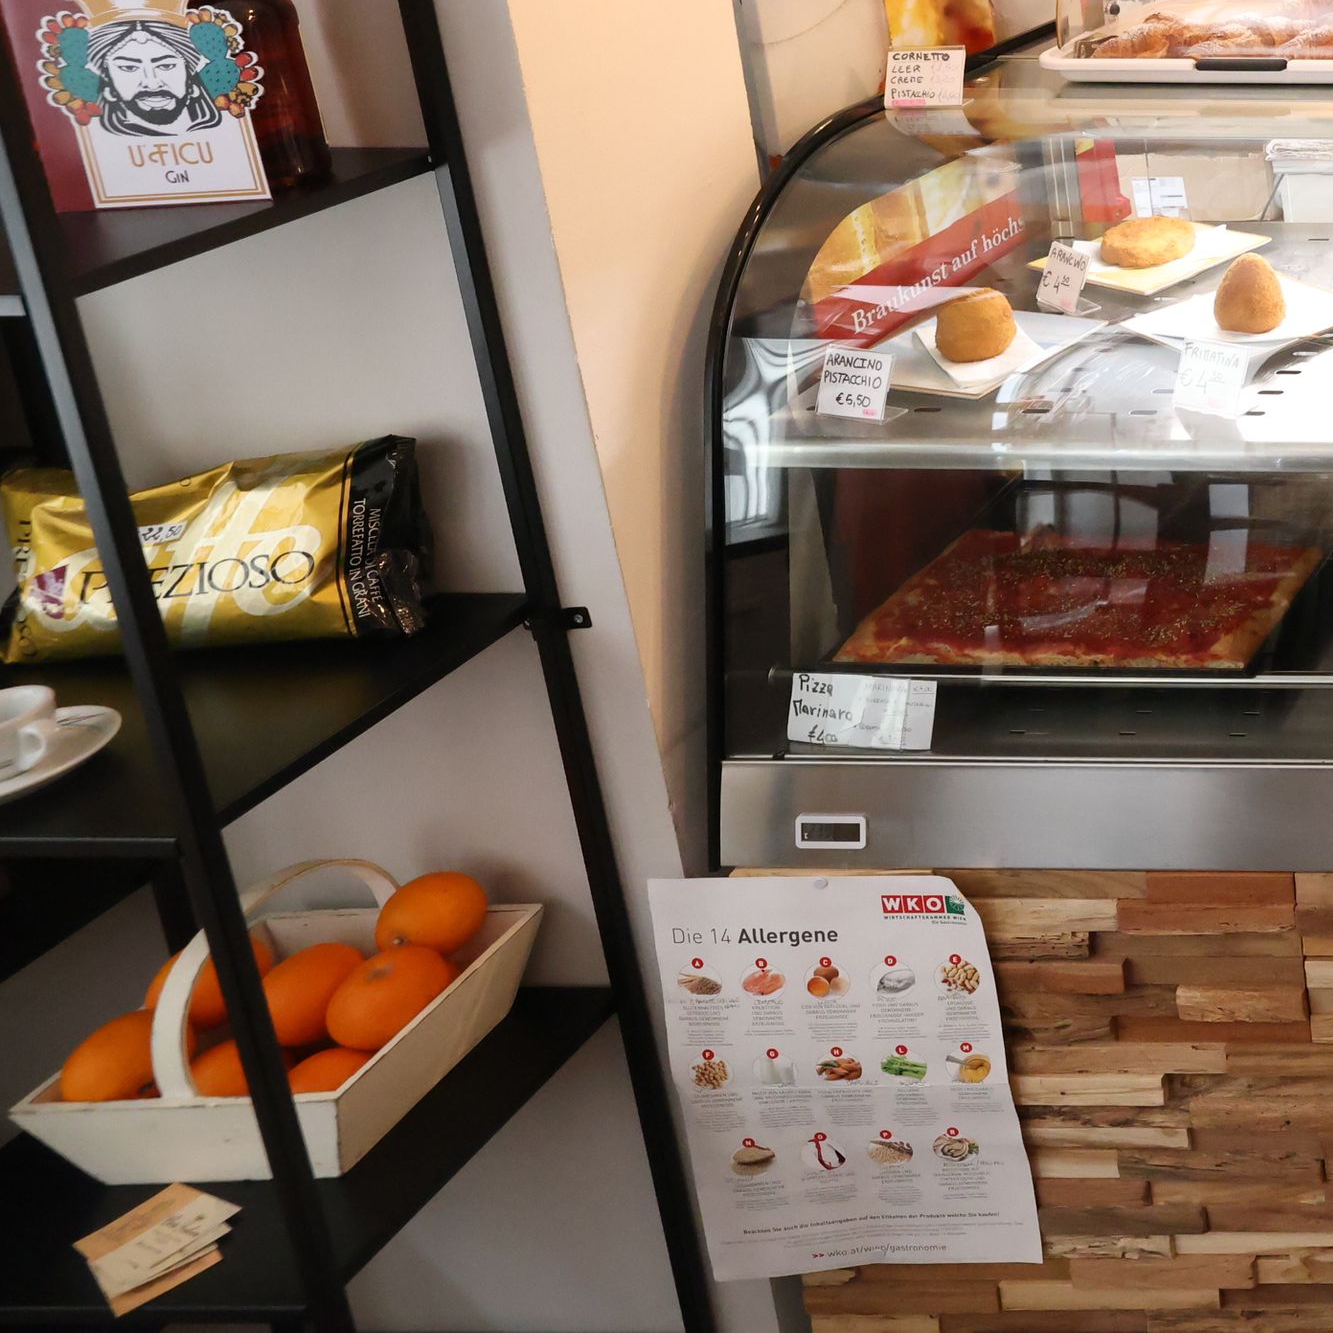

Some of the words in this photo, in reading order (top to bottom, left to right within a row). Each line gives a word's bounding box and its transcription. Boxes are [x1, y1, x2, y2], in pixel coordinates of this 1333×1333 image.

[892, 52, 950, 61] CORNETTO
[891, 65, 921, 74] LEER
[851, 263, 949, 334] Braukunst
[951, 240, 979, 272] auf
[981, 217, 1025, 253] höchs
[826, 352, 883, 371] ARANCINO
[823, 370, 882, 389] PISTACCHIO
[79, 549, 315, 606] PEZIOSO
[798, 674, 834, 697] Pizza
[882, 897, 942, 911] WKO
[672, 927, 702, 944] Die
[711, 927, 731, 944] 14
[737, 928, 838, 947] Allergene
